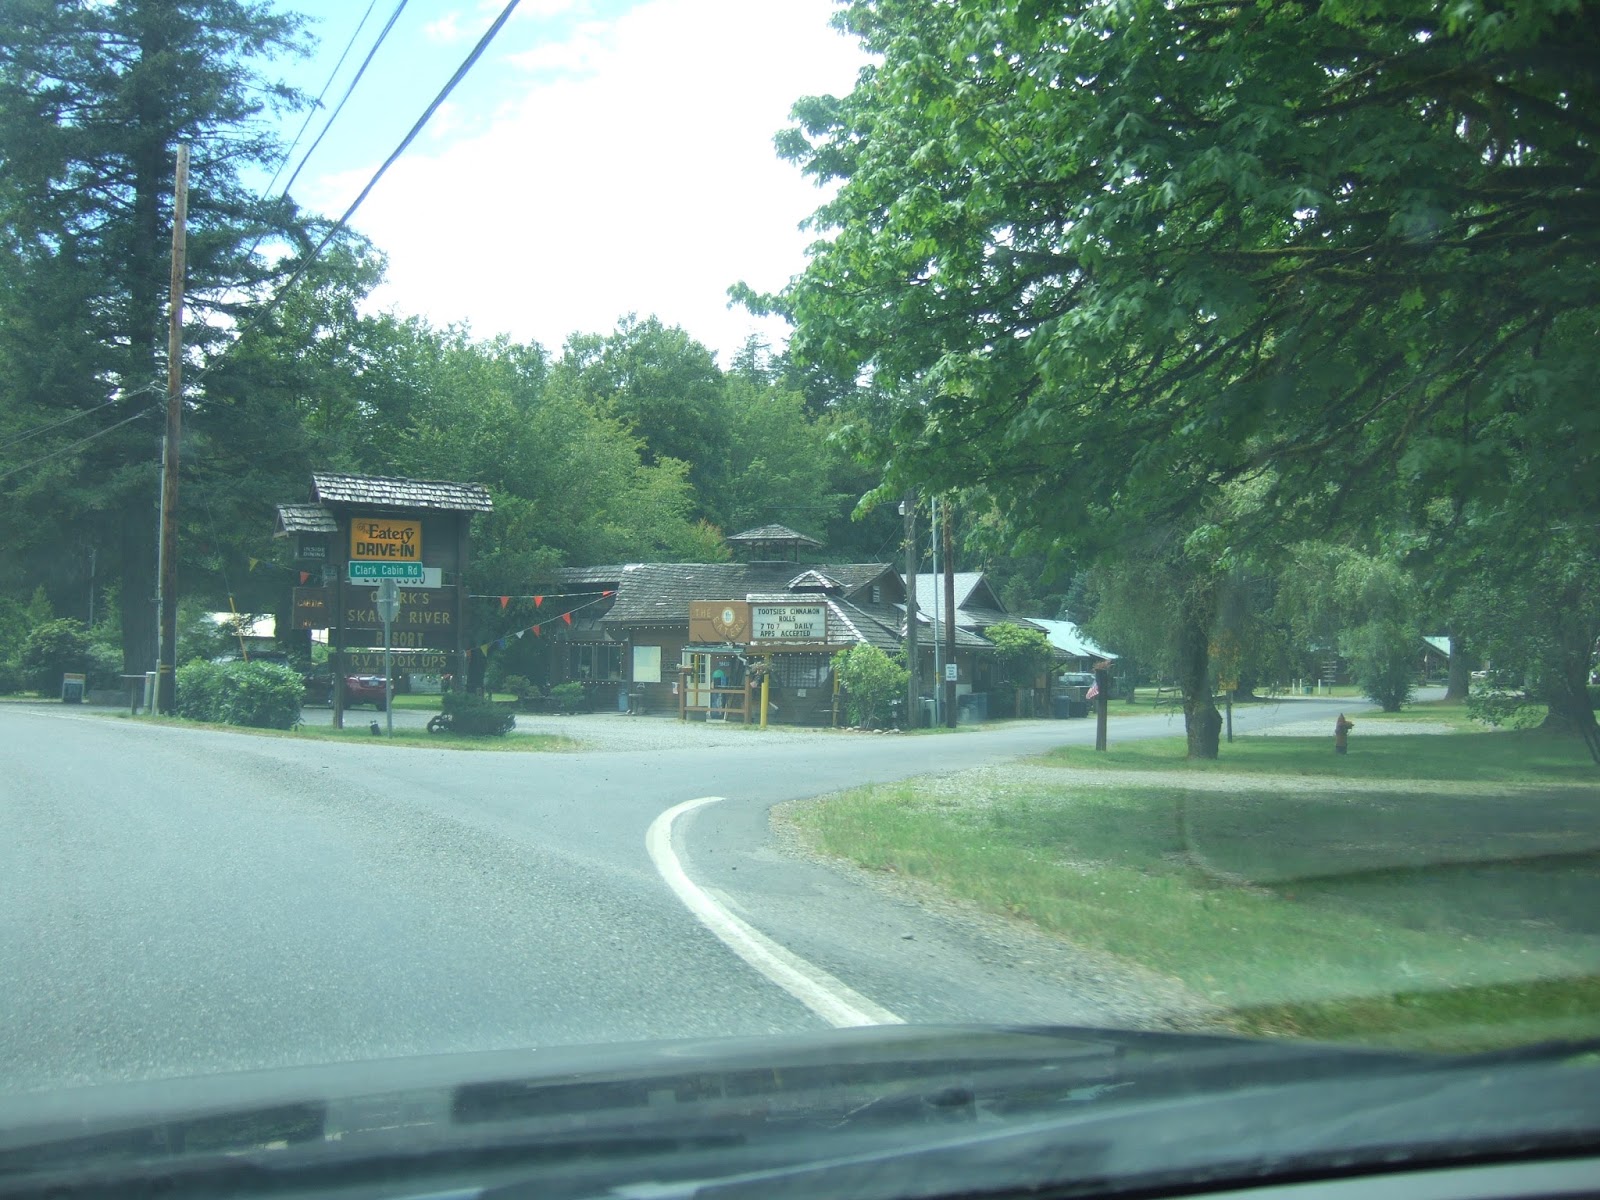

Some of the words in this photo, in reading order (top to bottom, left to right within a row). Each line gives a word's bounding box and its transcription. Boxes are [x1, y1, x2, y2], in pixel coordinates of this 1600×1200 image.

[368, 523, 415, 544] Eatery
[356, 541, 415, 557] DRIVE-IN
[355, 565, 377, 575] Clark
[381, 565, 404, 575] Cabin
[407, 565, 418, 575] Rd
[370, 590, 430, 605] CRK'S
[409, 611, 451, 624] RIVER
[694, 608, 711, 618] THE
[376, 631, 424, 647] RSORT
[421, 656, 447, 668] UPS
